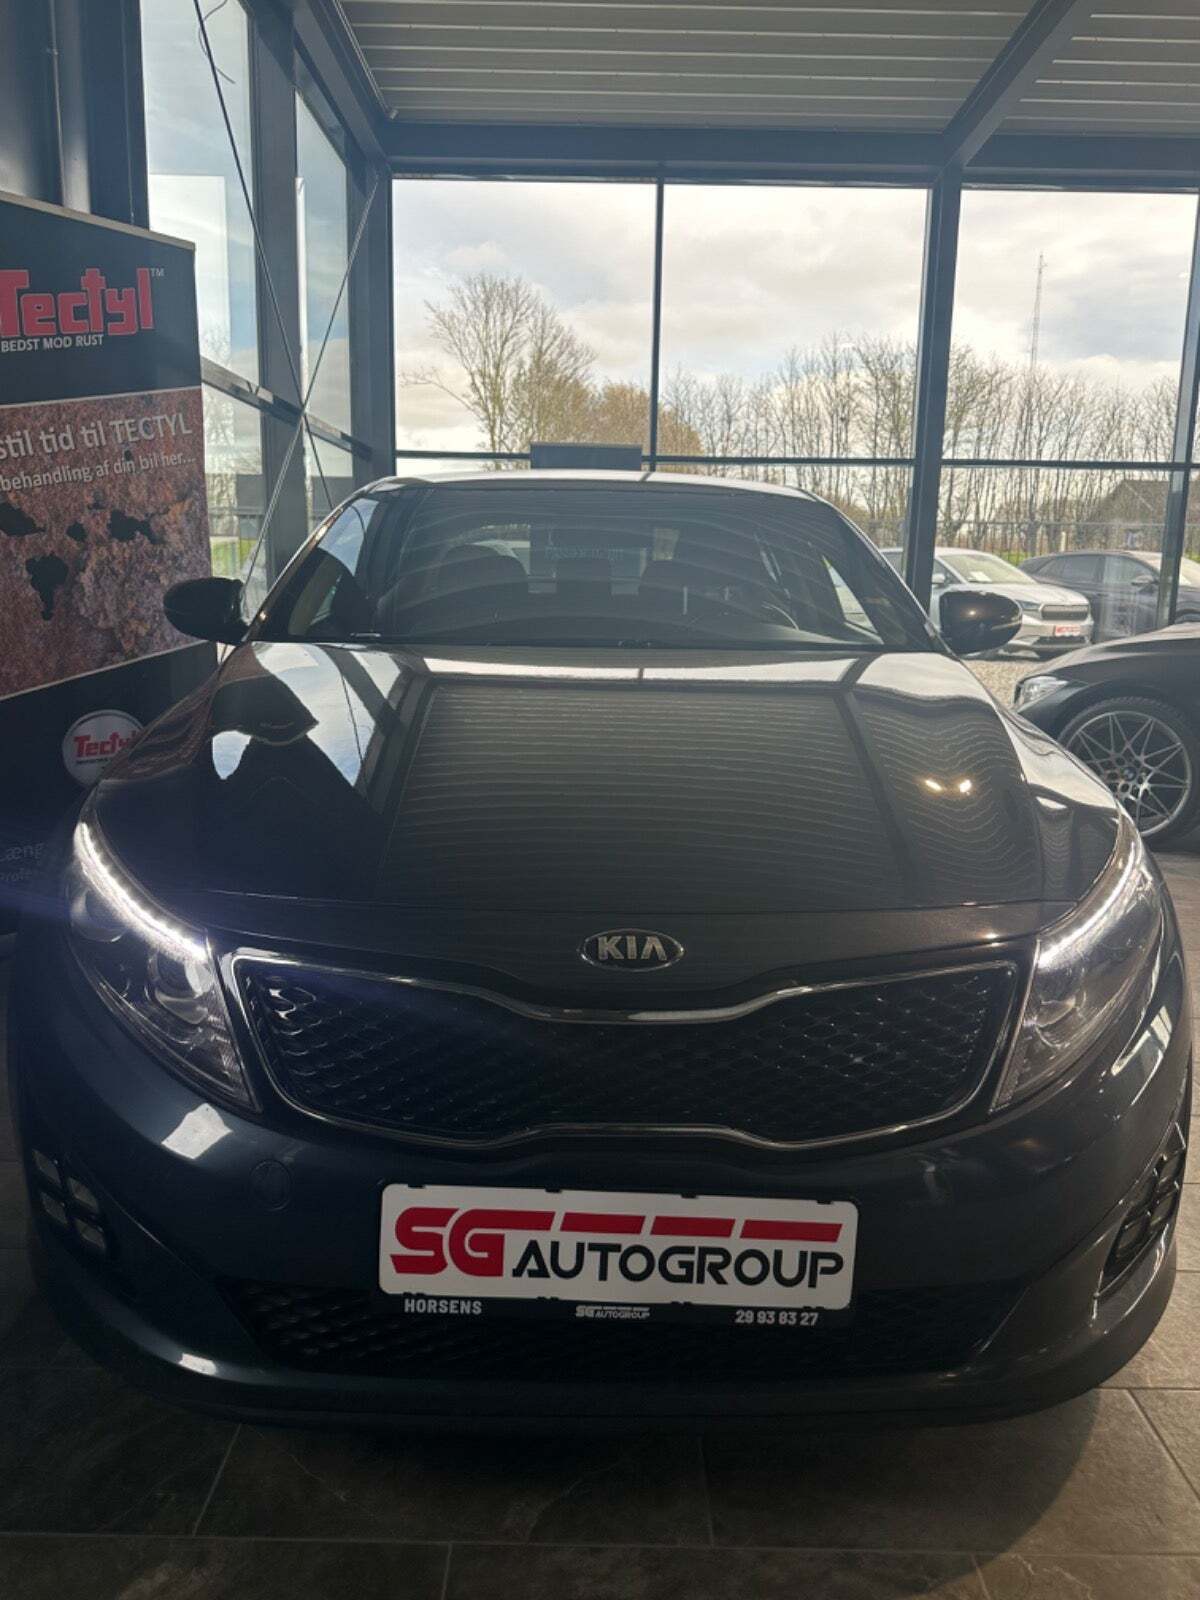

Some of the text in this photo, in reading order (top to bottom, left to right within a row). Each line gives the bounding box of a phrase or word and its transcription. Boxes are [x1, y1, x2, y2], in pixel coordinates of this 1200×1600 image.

[0, 268, 154, 337] Tectyl
[1, 334, 103, 352] BEDST MOD RUST
[40, 424, 75, 453] tid
[81, 421, 106, 448] til
[110, 413, 192, 444] TECTYL
[96, 462, 109, 477] af
[114, 458, 136, 475] din
[140, 453, 160, 470] bil
[162, 451, 196, 466] her...
[597, 935, 668, 961] KIA
[390, 1206, 843, 1288] SG AUTOGROUP
[404, 1298, 482, 1316] HORSENS
[735, 1309, 754, 1324] 29
[757, 1310, 775, 1325] 93
[800, 1312, 819, 1327] 27
